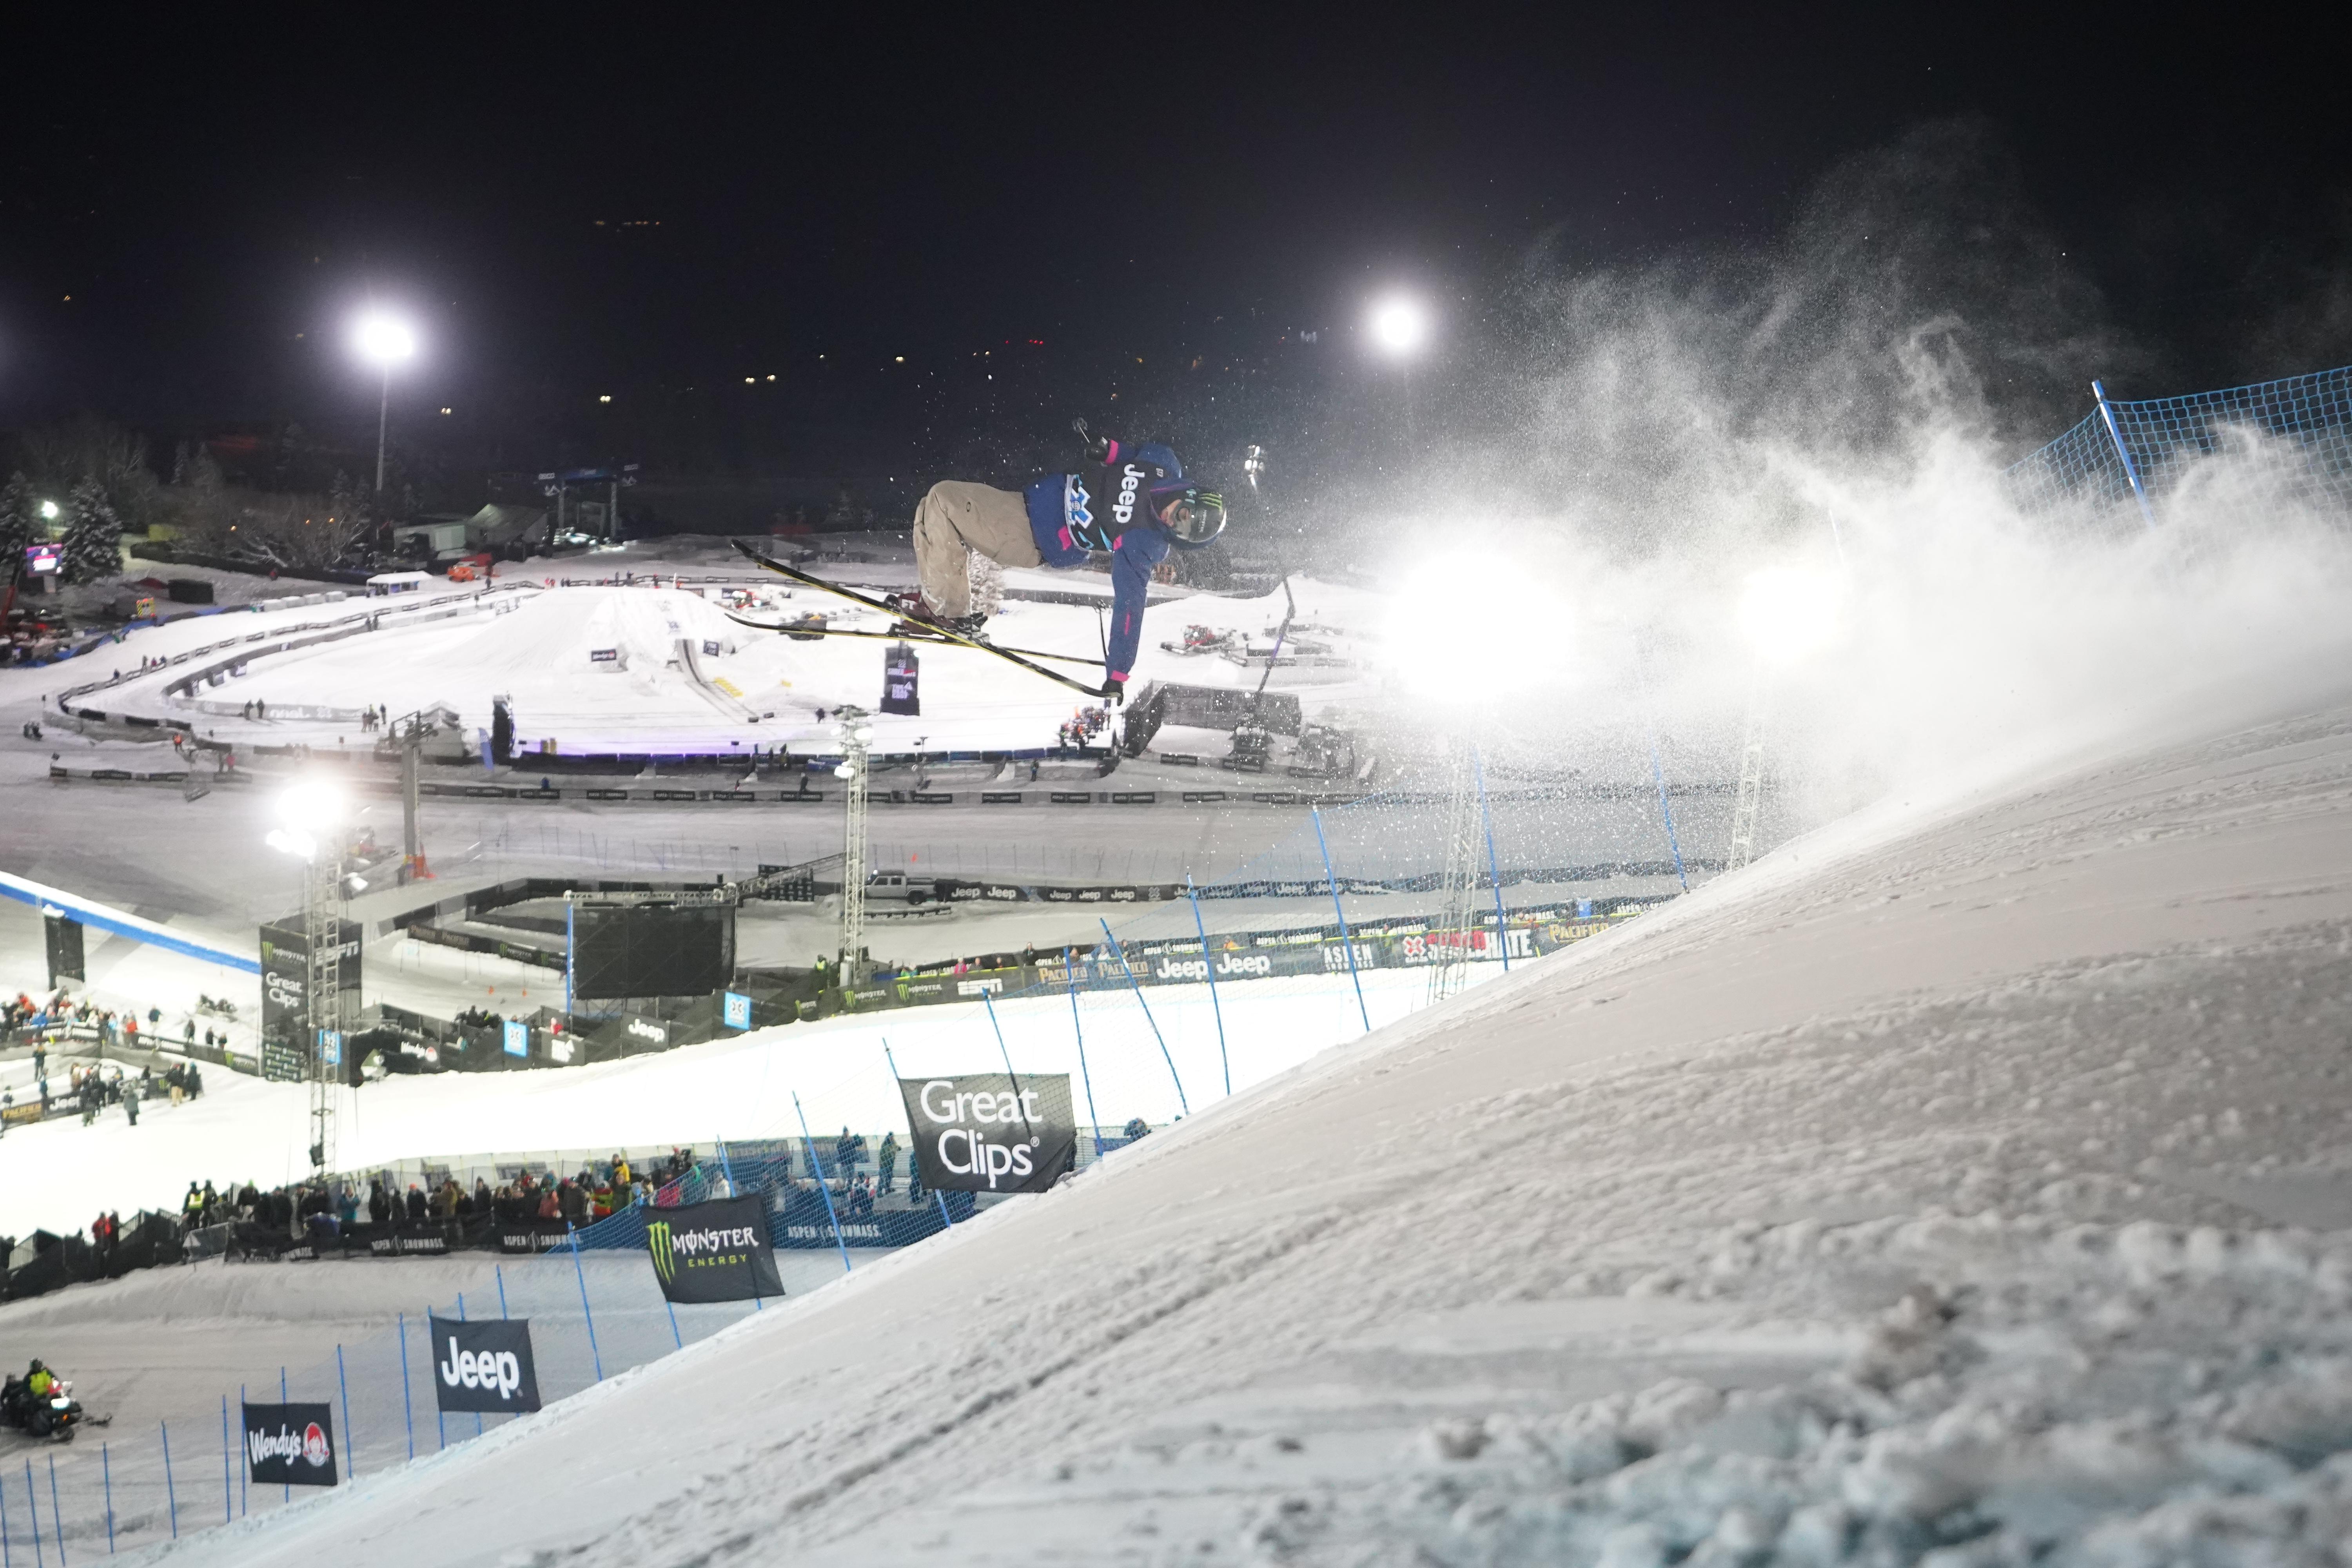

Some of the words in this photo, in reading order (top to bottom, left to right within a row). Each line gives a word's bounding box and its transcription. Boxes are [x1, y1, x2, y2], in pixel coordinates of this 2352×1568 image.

[1112, 463, 1145, 523] Jeep
[951, 887, 980, 898] Jeep
[987, 886, 1016, 899] Jeep
[1050, 890, 1071, 900] Jeep
[1079, 889, 1100, 900] Jeep
[1111, 889, 1134, 900] Jeep
[1276, 883, 1307, 894] Jeep
[1157, 958, 1208, 980] Jeep
[1216, 953, 1270, 975] Jeep
[266, 971, 302, 993] Great
[957, 978, 1003, 996] ESPN
[855, 989, 886, 1000] MONSTER
[908, 984, 942, 994] MONSTER
[269, 987, 301, 1008] Clips
[628, 1018, 665, 1042] Jeep
[920, 1080, 1043, 1123] Great
[788, 1225, 816, 1238] ASPEN
[372, 1238, 390, 1250] ASPEN
[403, 1237, 444, 1249] SNOWMASS
[504, 1235, 526, 1246] ASPEN
[688, 1254, 747, 1268] ENERGY
[442, 1336, 519, 1399] Jeep
[249, 1423, 301, 1466] Wendy's
